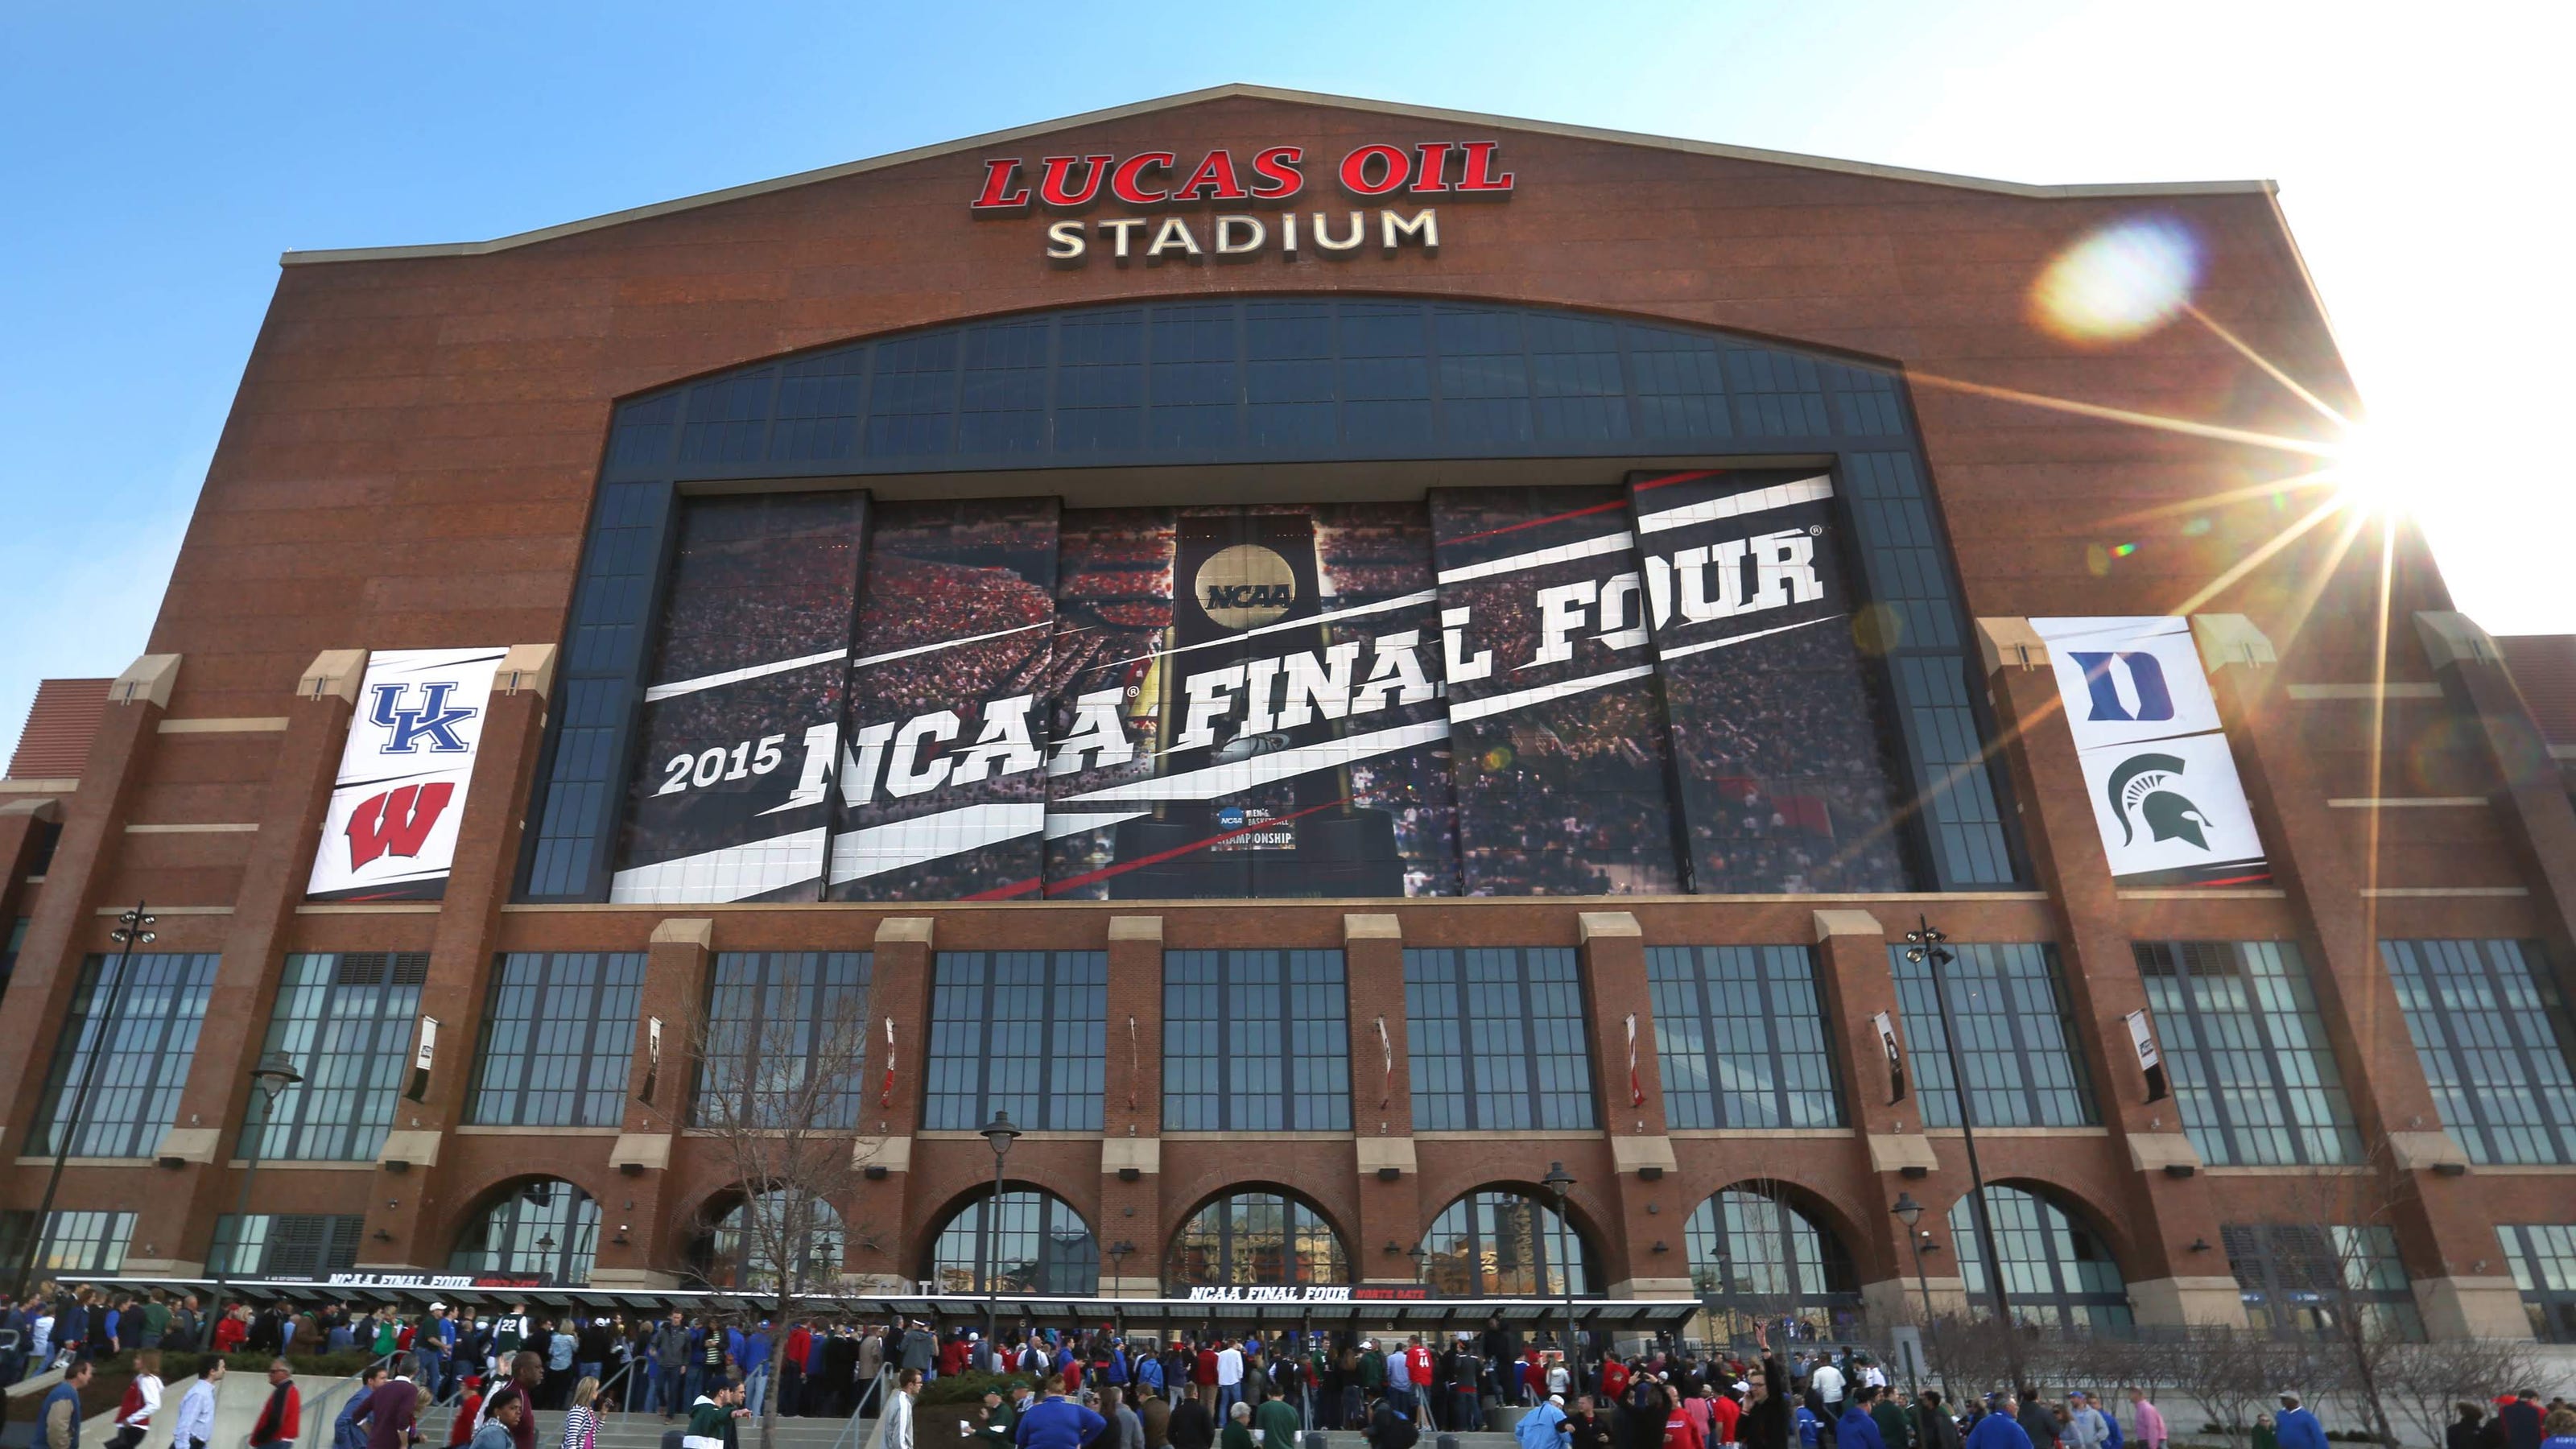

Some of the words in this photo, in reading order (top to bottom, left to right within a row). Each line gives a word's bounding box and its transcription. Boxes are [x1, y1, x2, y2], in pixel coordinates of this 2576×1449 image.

[971, 146, 1304, 211] LUCAS
[1339, 140, 1515, 200] OIL
[1046, 208, 1440, 266] STADIUM
[1205, 584, 1294, 610] NCAA
[648, 733, 786, 797] 2015
[753, 687, 1135, 816] NCAA
[1150, 607, 1494, 758] FINAL
[1511, 526, 1825, 672] FOUR
[2066, 651, 2175, 721] D
[369, 681, 478, 754] UK
[344, 782, 456, 873] W
[1217, 833, 1292, 844] AMPIONSHIP
[1248, 818, 1289, 826] BASKALL
[328, 1274, 377, 1285] NCAA
[380, 1274, 426, 1286] FINAL
[1188, 1287, 1243, 1300] NCAA
[1247, 1287, 1299, 1300] FINAL
[1301, 1287, 1352, 1300] FOUR
[501, 1319, 517, 1331] 22
